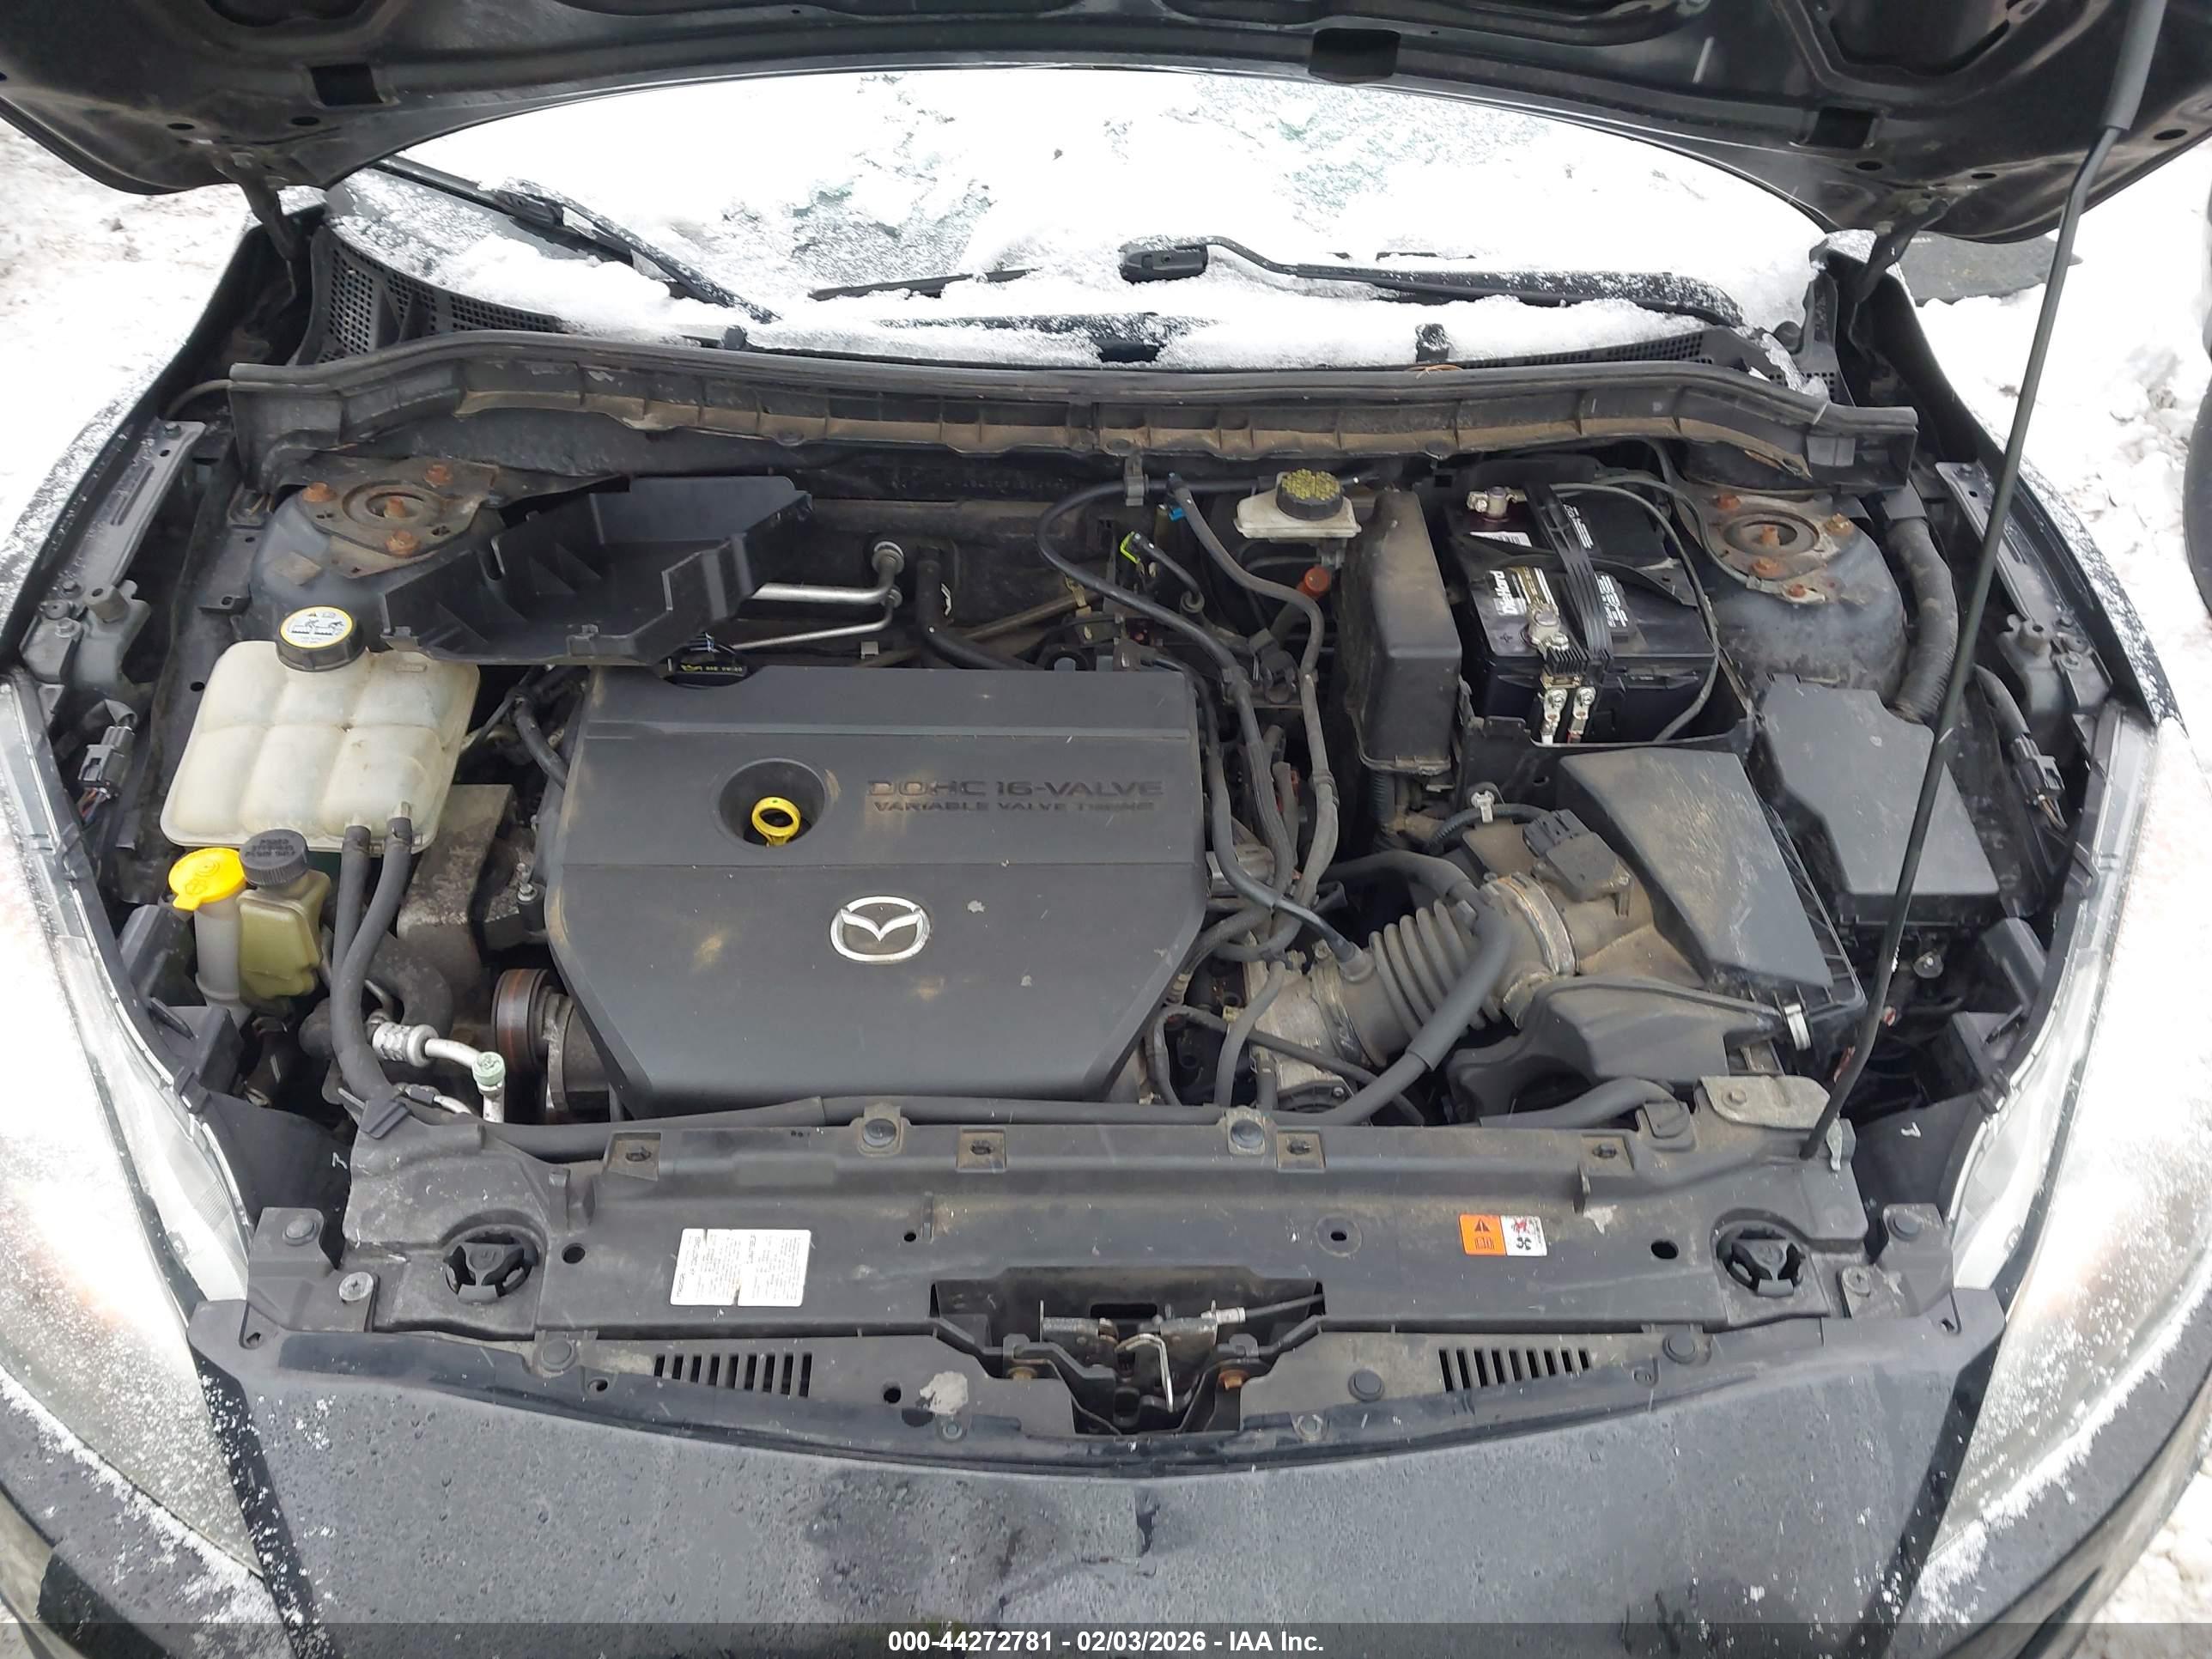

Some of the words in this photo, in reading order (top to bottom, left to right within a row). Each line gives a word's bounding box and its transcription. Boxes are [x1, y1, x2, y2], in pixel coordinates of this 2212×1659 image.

[1490, 569, 1518, 615] DieHard
[866, 780, 988, 798] DOHC
[997, 780, 1164, 798] 16-VALVE
[873, 801, 989, 812] VARIABLE
[997, 801, 1068, 812] VALVE
